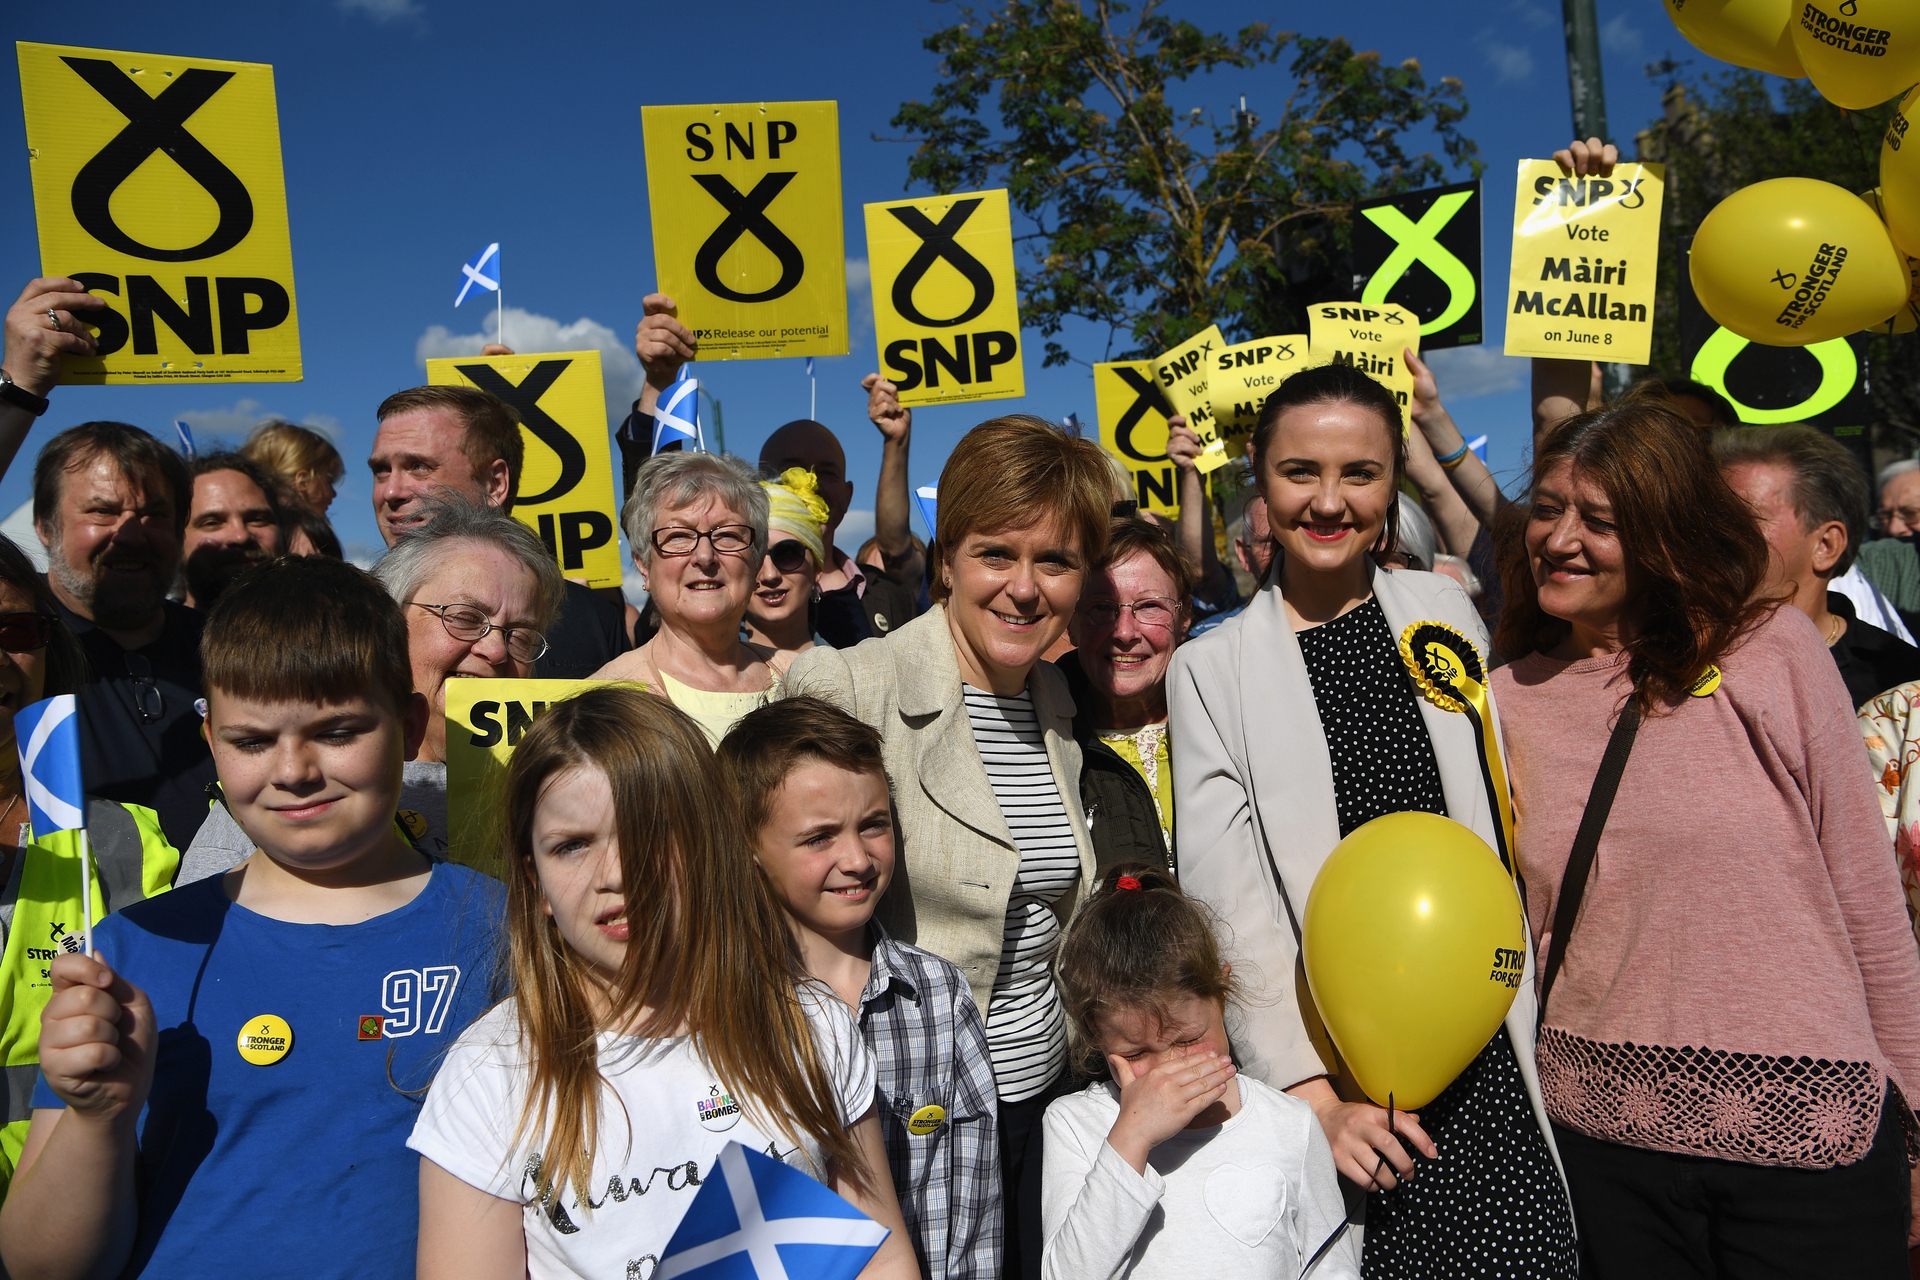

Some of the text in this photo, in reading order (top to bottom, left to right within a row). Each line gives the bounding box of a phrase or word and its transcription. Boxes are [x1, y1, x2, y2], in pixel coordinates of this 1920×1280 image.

[1801, 18, 1886, 57] FOR SCOTLAND
[1803, 3, 1891, 45] STRONGER
[684, 121, 798, 162] SNP
[1533, 176, 1614, 207] SNP
[1566, 224, 1609, 242] Vote
[1540, 256, 1627, 286] Màiri
[1776, 243, 1836, 327] STRONGER
[1791, 247, 1848, 329] FOR SCOTLAND
[65, 272, 290, 356] SNP
[1321, 307, 1380, 323] SNP
[1513, 290, 1646, 323] McAllan
[714, 328, 755, 339] Release
[758, 329, 777, 338] our
[780, 325, 829, 339] potential
[1349, 329, 1382, 342] Vote
[1544, 330, 1613, 345] on June 8
[884, 331, 1016, 391] SNP
[1158, 350, 1200, 387] SNP
[1218, 346, 1273, 370] SNP
[1332, 350, 1394, 377] Màiri
[1243, 375, 1274, 388] Vote
[1443, 668, 1458, 680] SNP
[469, 700, 560, 748] SN
[1489, 970, 1507, 982] FOR
[382, 965, 460, 1038] 97
[246, 1036, 285, 1045] TRONGER
[705, 1103, 740, 1120] BOMBS
